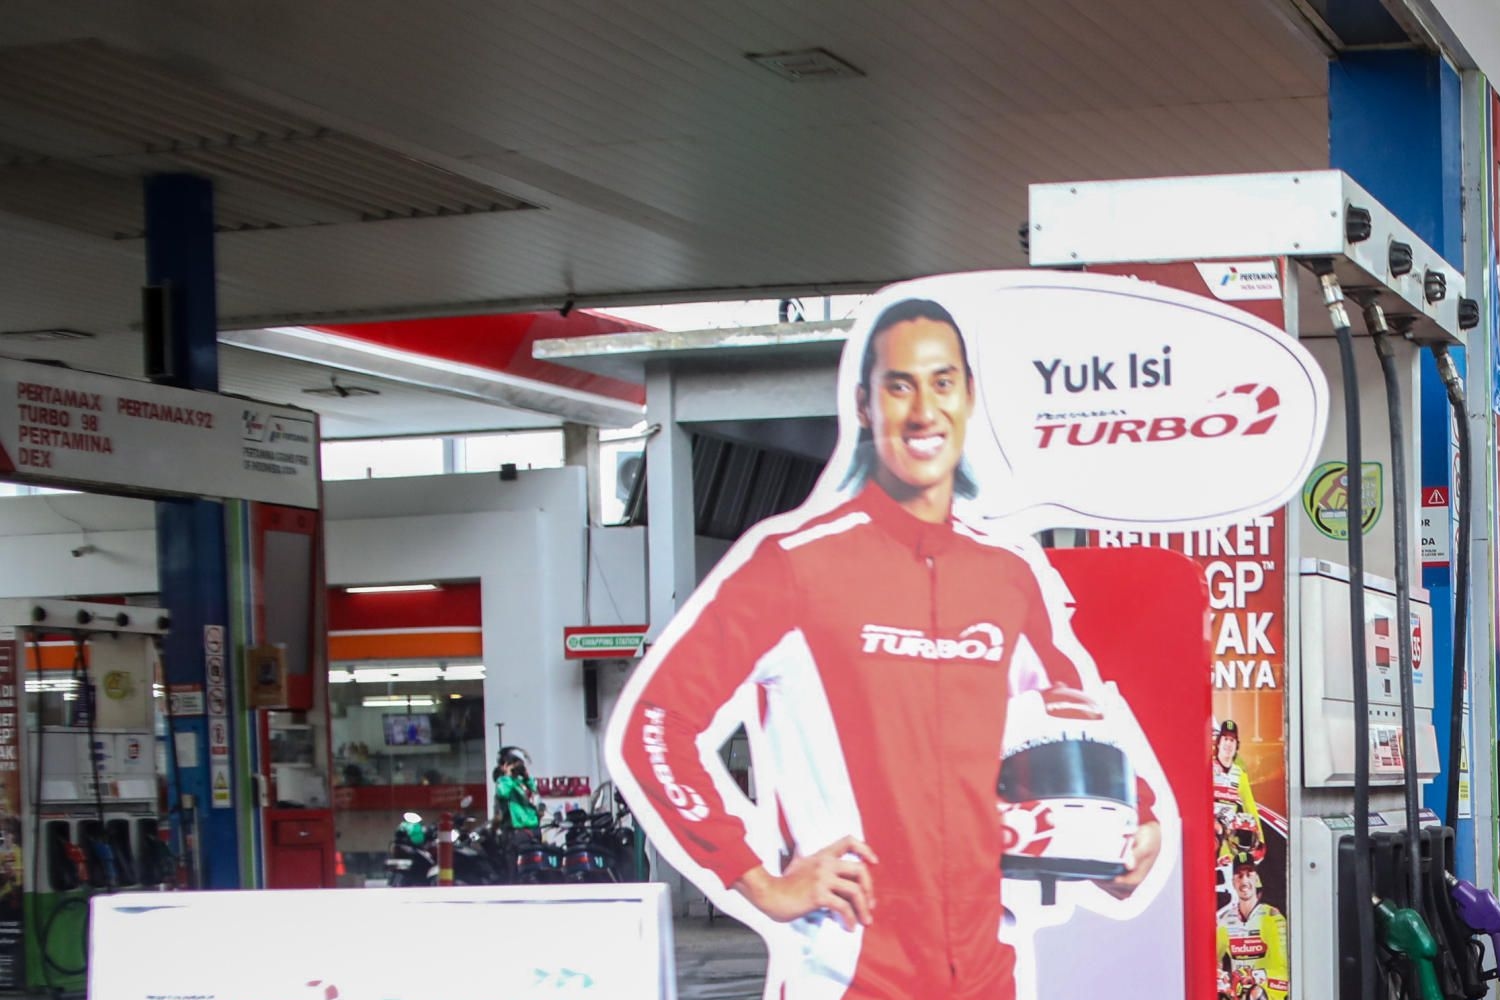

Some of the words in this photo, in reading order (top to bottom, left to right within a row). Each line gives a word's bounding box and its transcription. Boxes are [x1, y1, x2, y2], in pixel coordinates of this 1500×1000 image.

[1032, 356, 1117, 394] Yuk
[1129, 345, 1172, 388] Isi
[17, 381, 103, 412] PERTAMAX
[18, 403, 70, 427] TURBO
[81, 414, 98, 432] 98
[1034, 414, 1238, 449] TURBO
[18, 425, 113, 455] PERTAMINA
[18, 447, 52, 469] DEX
[860, 632, 987, 660] TURBO
